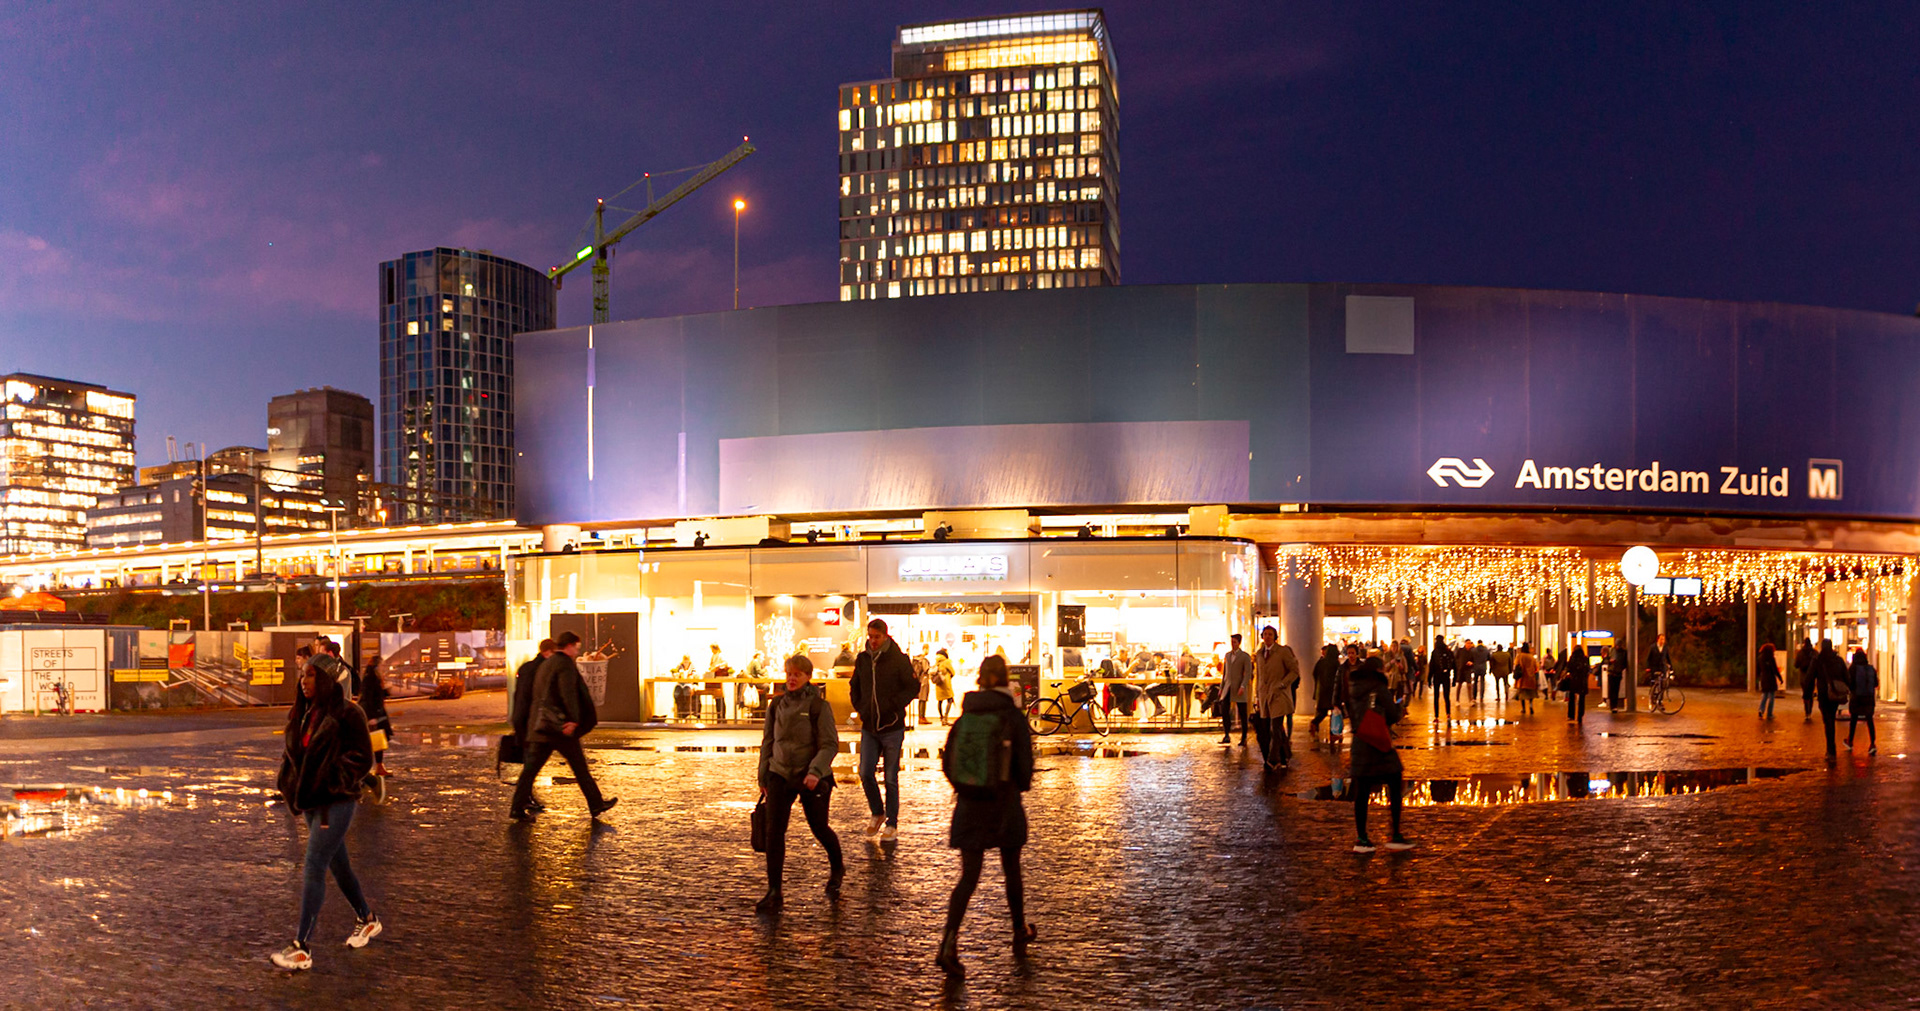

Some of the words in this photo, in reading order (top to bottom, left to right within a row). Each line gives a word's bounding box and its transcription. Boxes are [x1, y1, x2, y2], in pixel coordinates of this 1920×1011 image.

[1514, 460, 1710, 494] Amsterdam
[1719, 466, 1790, 498] Zuid
[1808, 468, 1837, 499] M
[34, 649, 74, 658] STREETS
[43, 660, 57, 668] OF
[35, 672, 51, 681] THE
